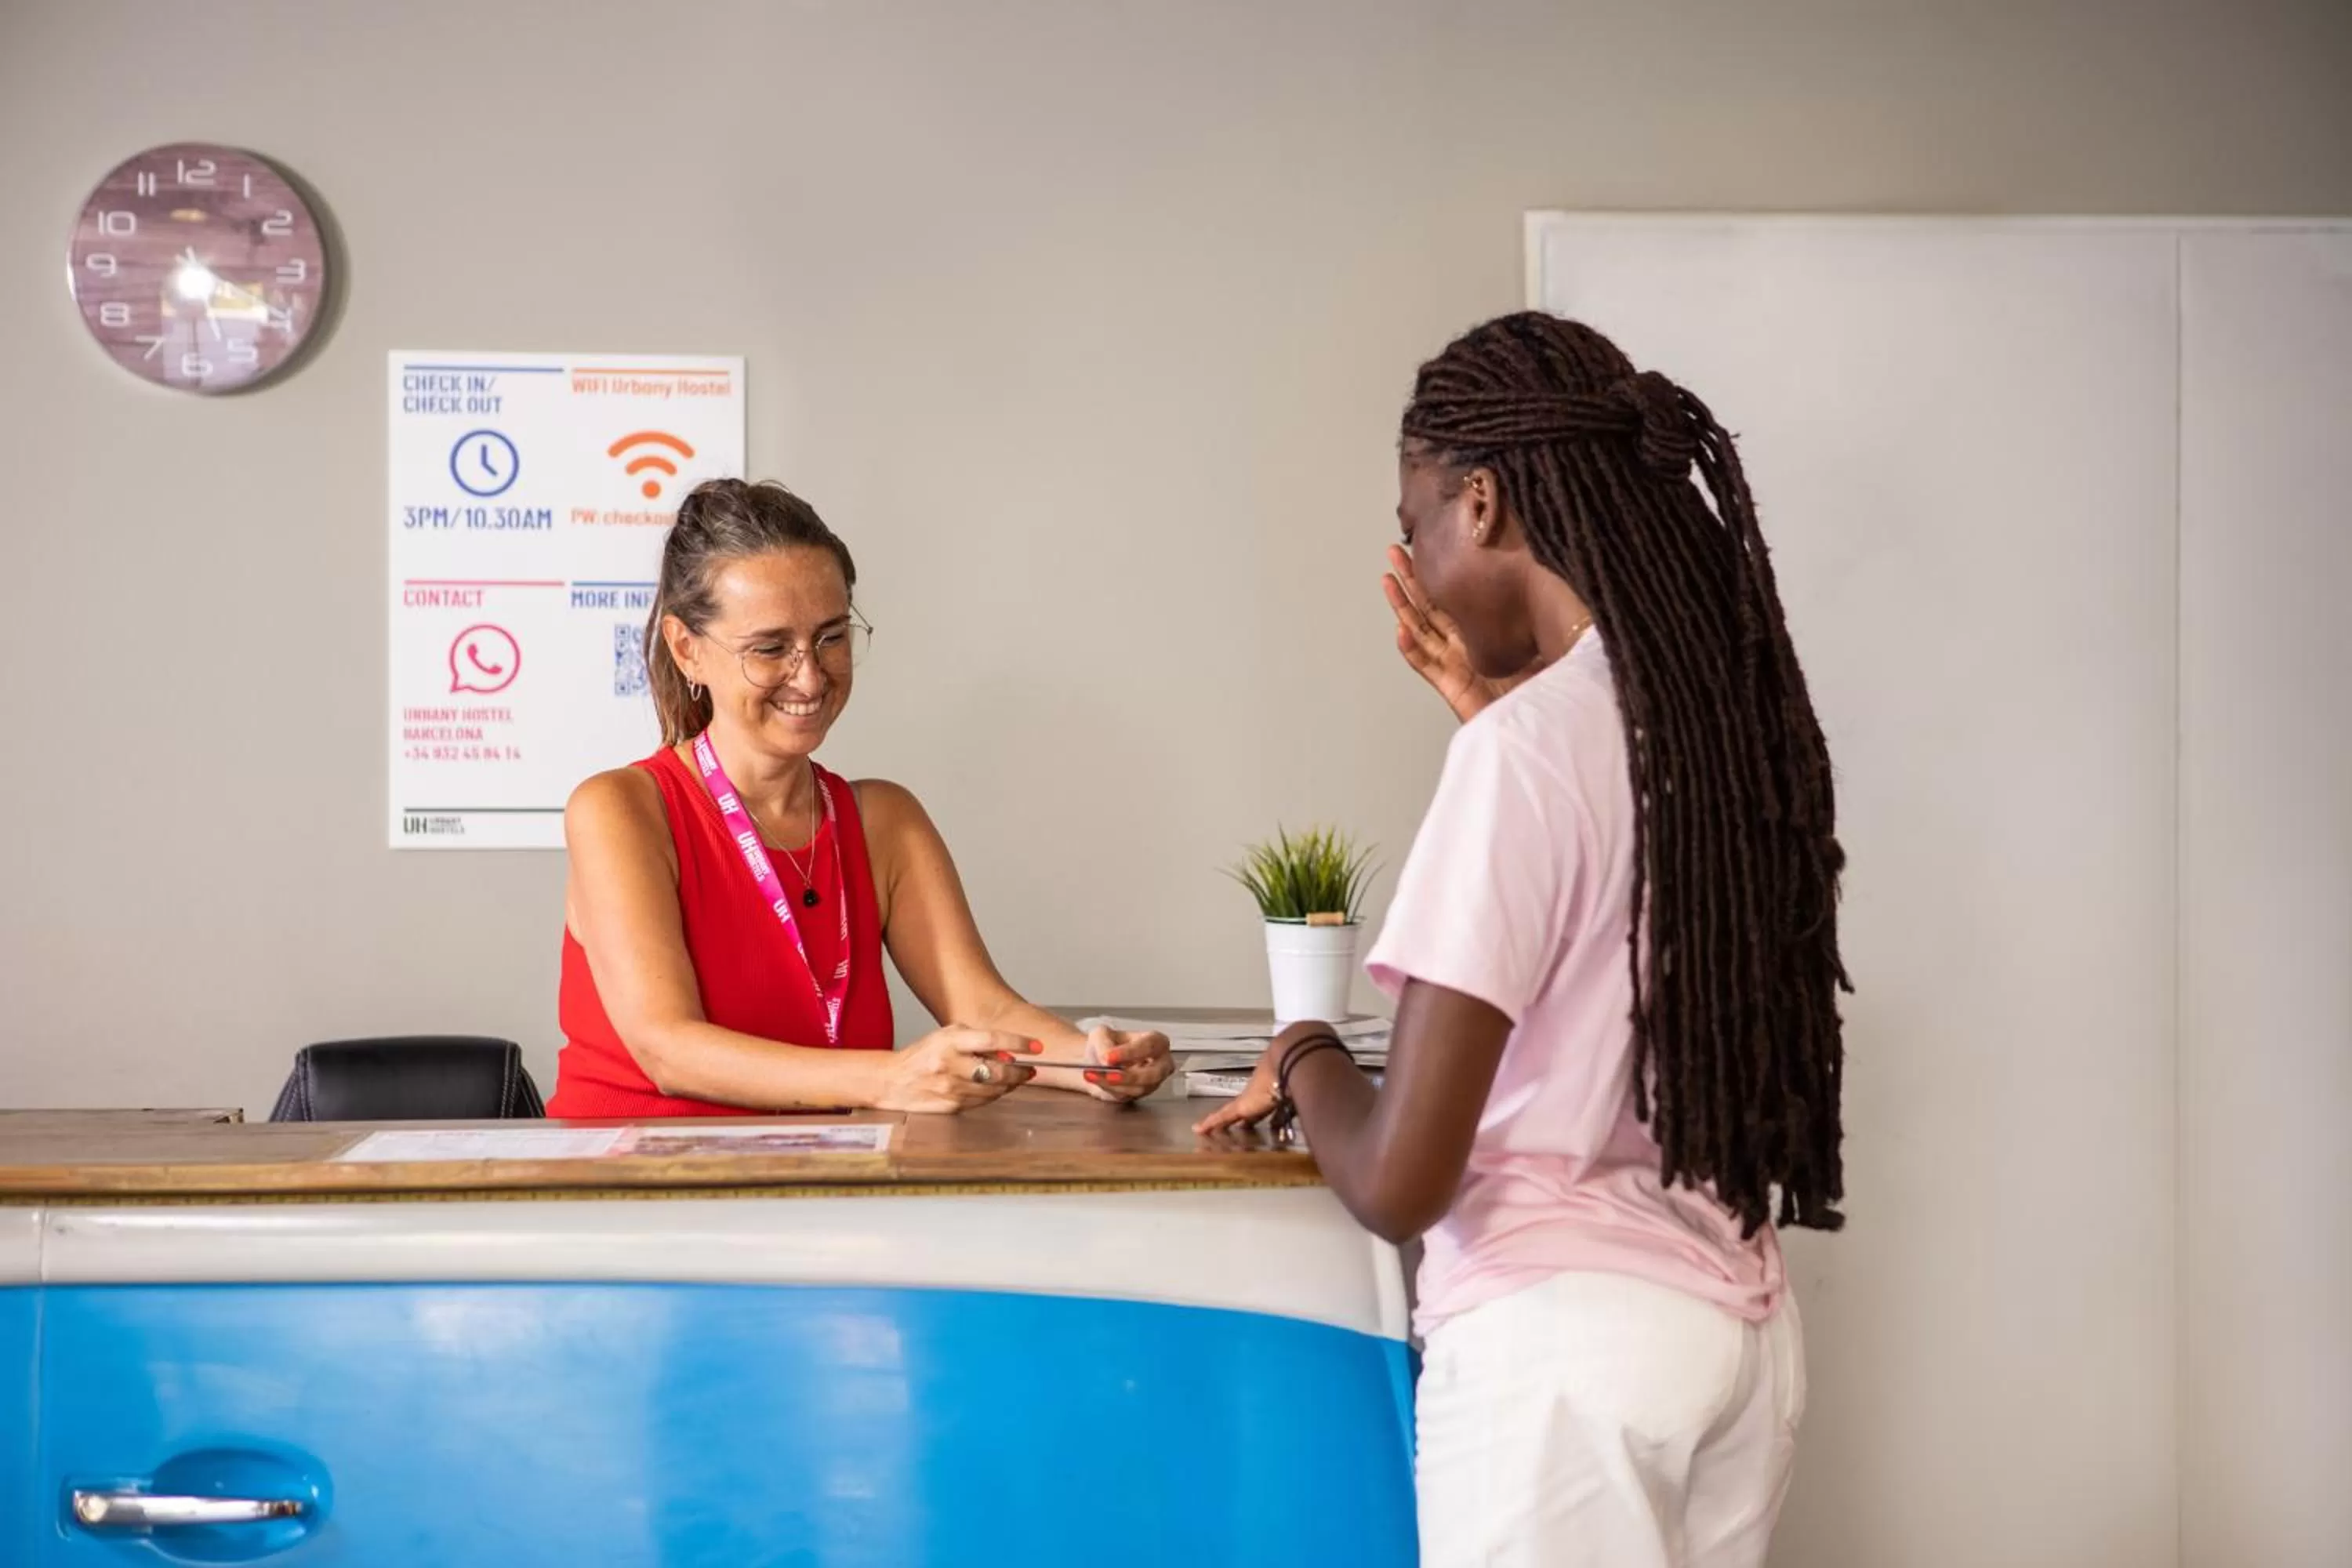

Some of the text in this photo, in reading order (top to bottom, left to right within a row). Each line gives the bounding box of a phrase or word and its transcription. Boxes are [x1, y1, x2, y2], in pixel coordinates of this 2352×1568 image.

[137, 170, 156, 197] 11
[176, 159, 216, 186] 12
[243, 172, 251, 198] 1
[97, 210, 136, 236] 10
[261, 209, 293, 235] 2
[85, 252, 117, 278] 9
[274, 258, 307, 284] 3
[100, 301, 131, 327] 8
[134, 334, 166, 361] 7
[227, 338, 259, 363] 5
[181, 352, 213, 377] 6
[403, 374, 496, 392] CHECK IN/
[403, 396, 503, 414] CHECK OUT
[403, 506, 553, 529] 3PM/10.30AM
[602, 508, 677, 526] checkou
[403, 590, 484, 608] CONTACT
[571, 591, 655, 609] MORE INF
[462, 707, 514, 723] HOSTEL
[403, 726, 484, 741] BARCELONA
[717, 793, 740, 815] UH
[403, 815, 427, 835] UH
[737, 830, 758, 854] UH
[773, 898, 791, 924] UH
